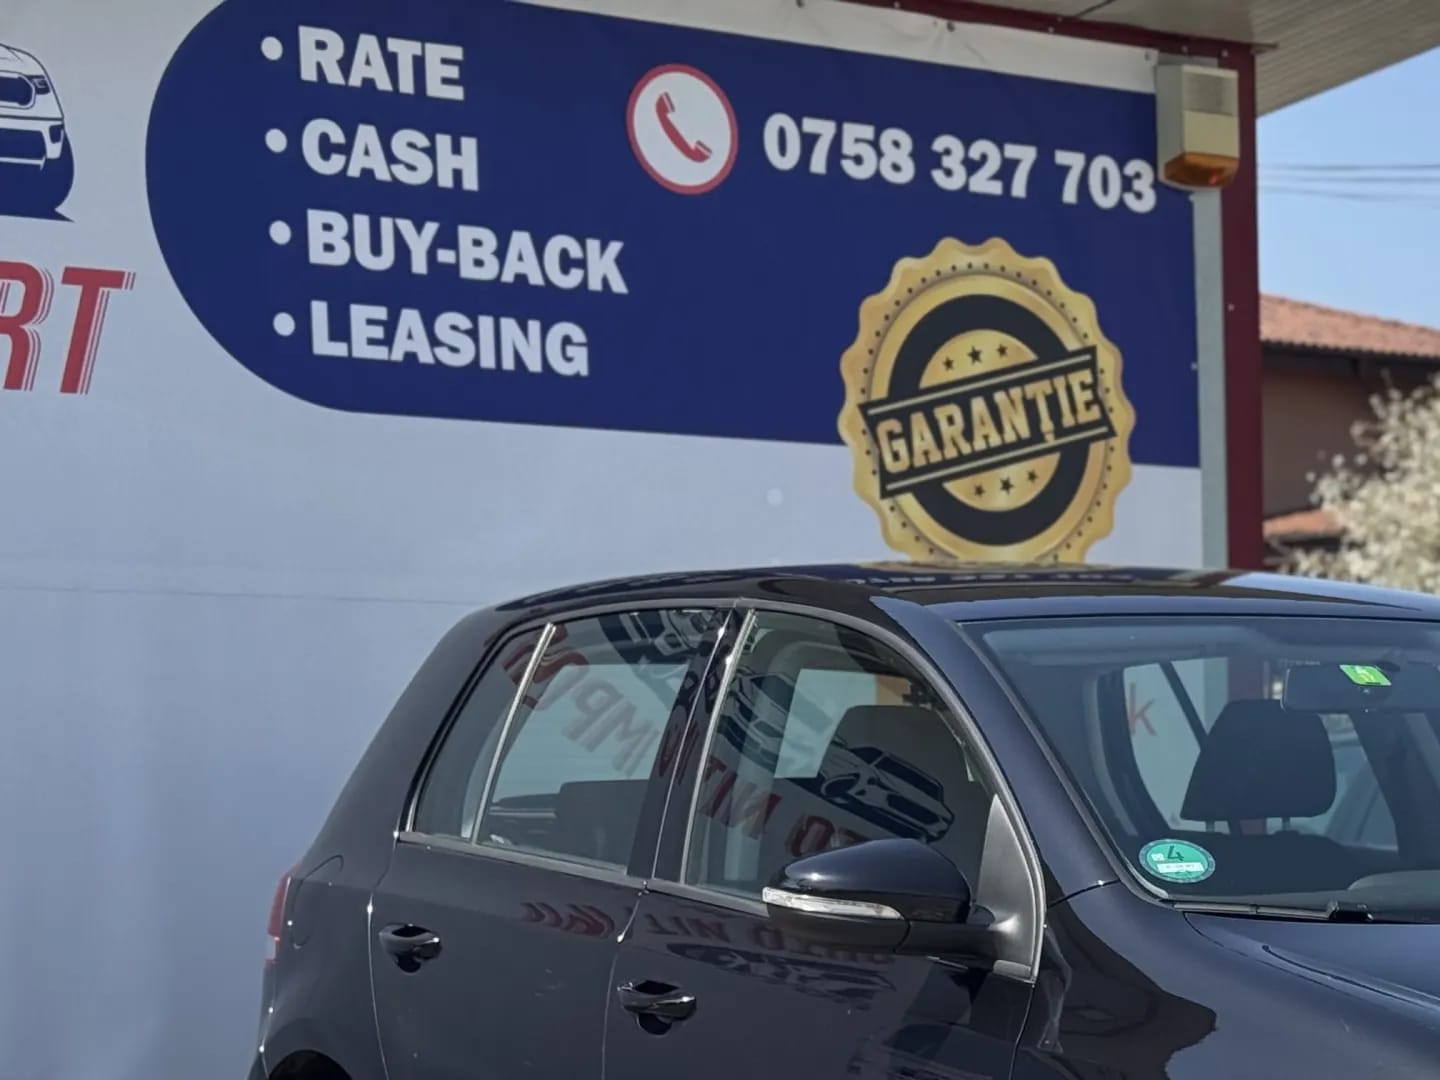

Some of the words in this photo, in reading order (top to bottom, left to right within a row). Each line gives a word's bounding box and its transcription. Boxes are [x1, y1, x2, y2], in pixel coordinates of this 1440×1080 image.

[299, 26, 465, 101] RATE
[302, 118, 480, 191] CASH
[763, 112, 916, 185] 0758
[930, 134, 1037, 199] 327
[1054, 149, 1157, 213] 703
[307, 208, 628, 294] BUY-BACK
[310, 300, 589, 377] LEASING
[1167, 845, 1185, 862] 4
